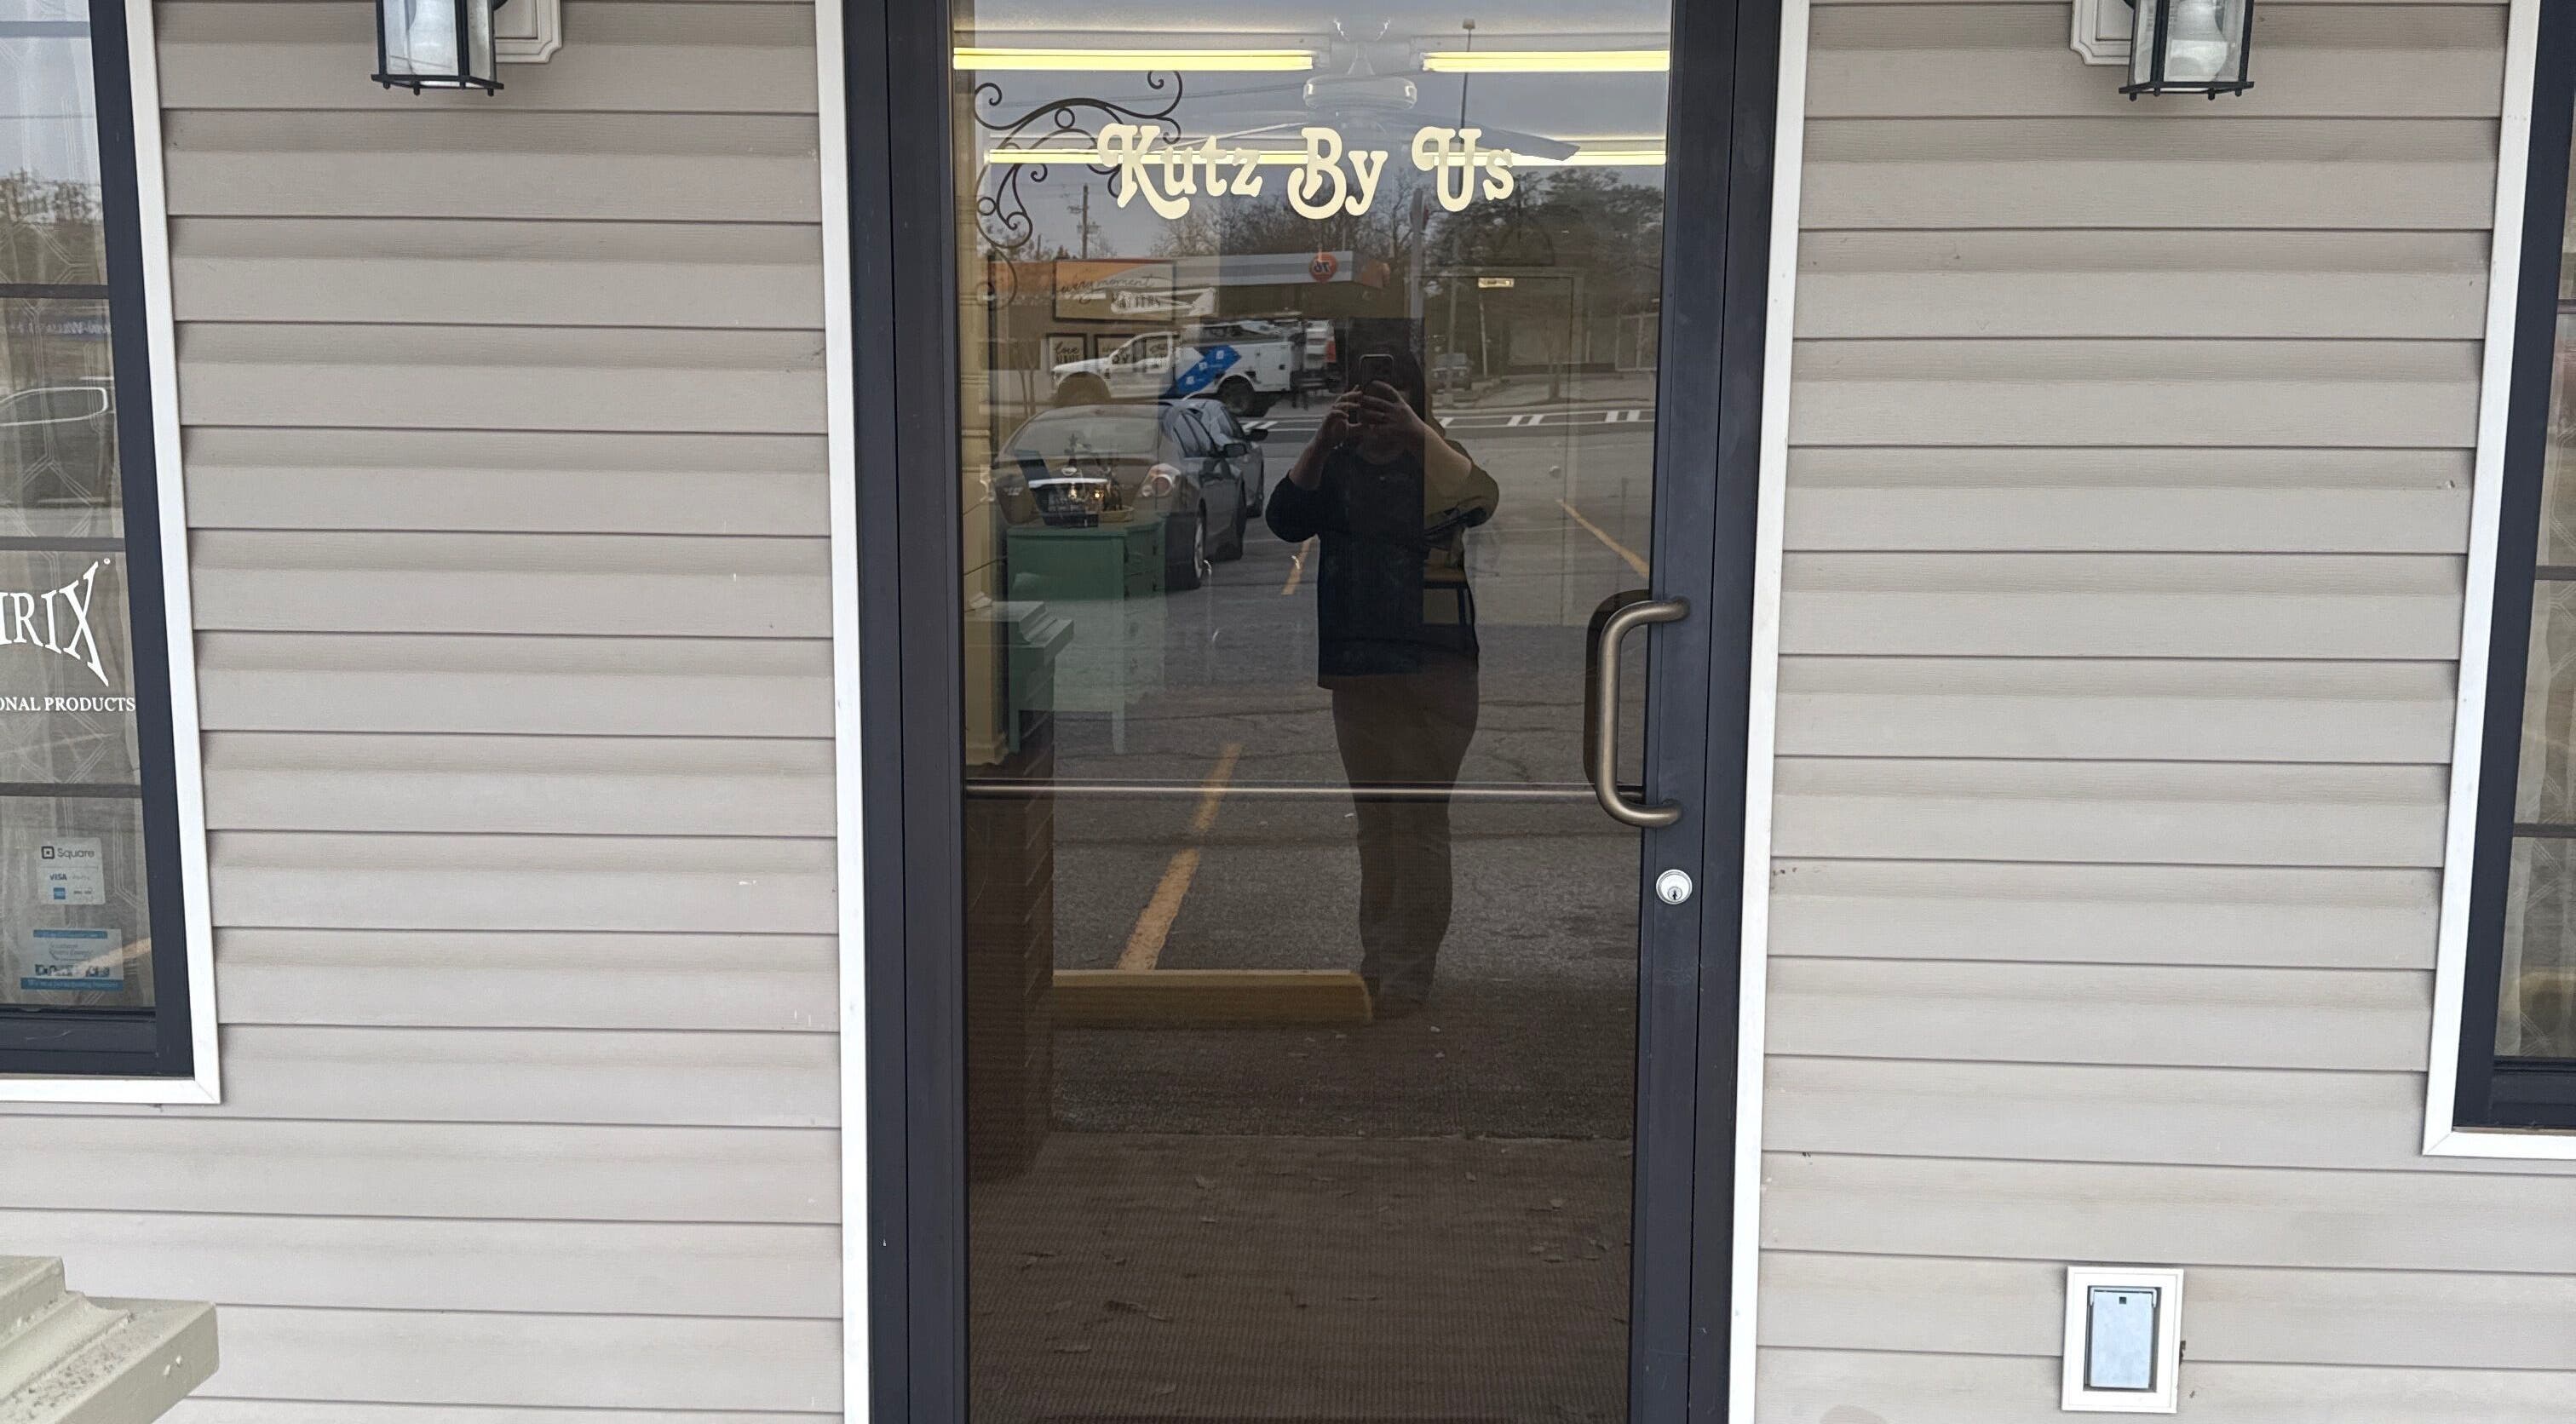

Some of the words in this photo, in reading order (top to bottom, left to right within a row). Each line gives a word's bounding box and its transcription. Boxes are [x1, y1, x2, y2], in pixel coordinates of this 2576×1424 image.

[1097, 123, 1262, 219] Kutz
[1287, 127, 1388, 219] By
[1412, 126, 1514, 211] Us
[44, 697, 135, 712] PRODUCTS
[57, 847, 95, 860] Square
